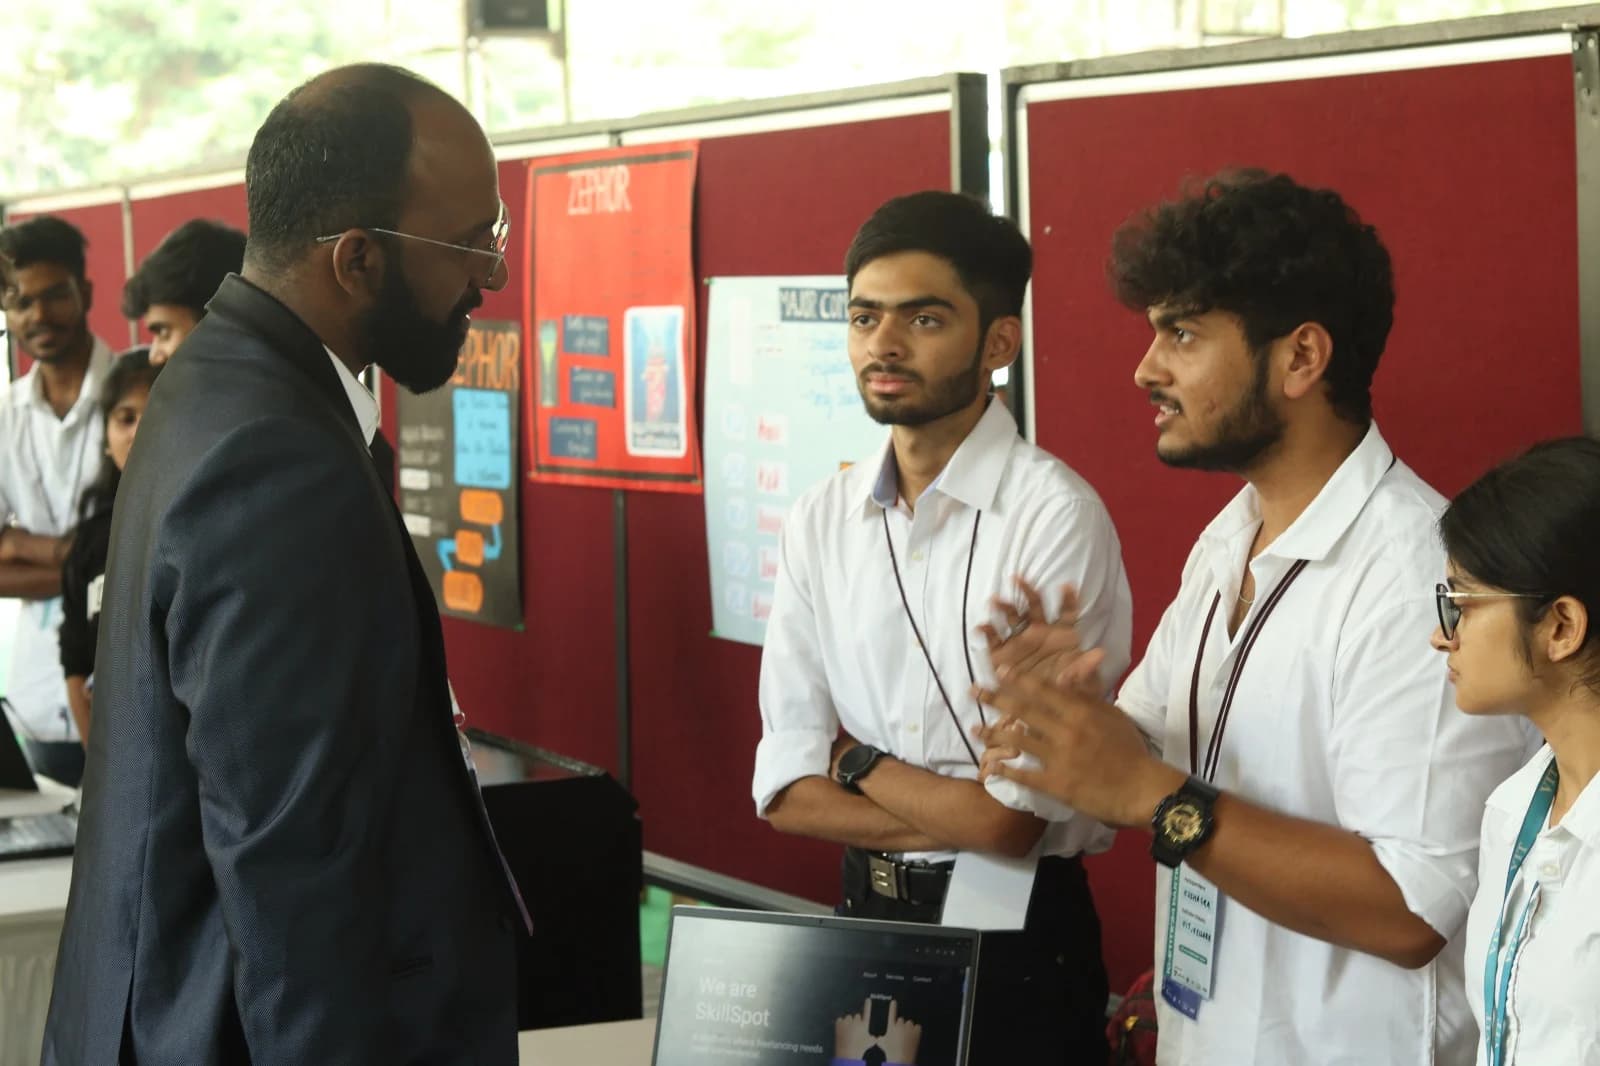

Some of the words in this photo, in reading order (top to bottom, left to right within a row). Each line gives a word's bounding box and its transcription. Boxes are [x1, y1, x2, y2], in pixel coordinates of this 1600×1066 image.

[567, 165, 632, 215] ZEPHOR
[1541, 766, 1558, 792] VIT
[699, 976, 727, 994] We
[729, 982, 758, 998] are
[695, 1001, 771, 1029] SkillSpot
